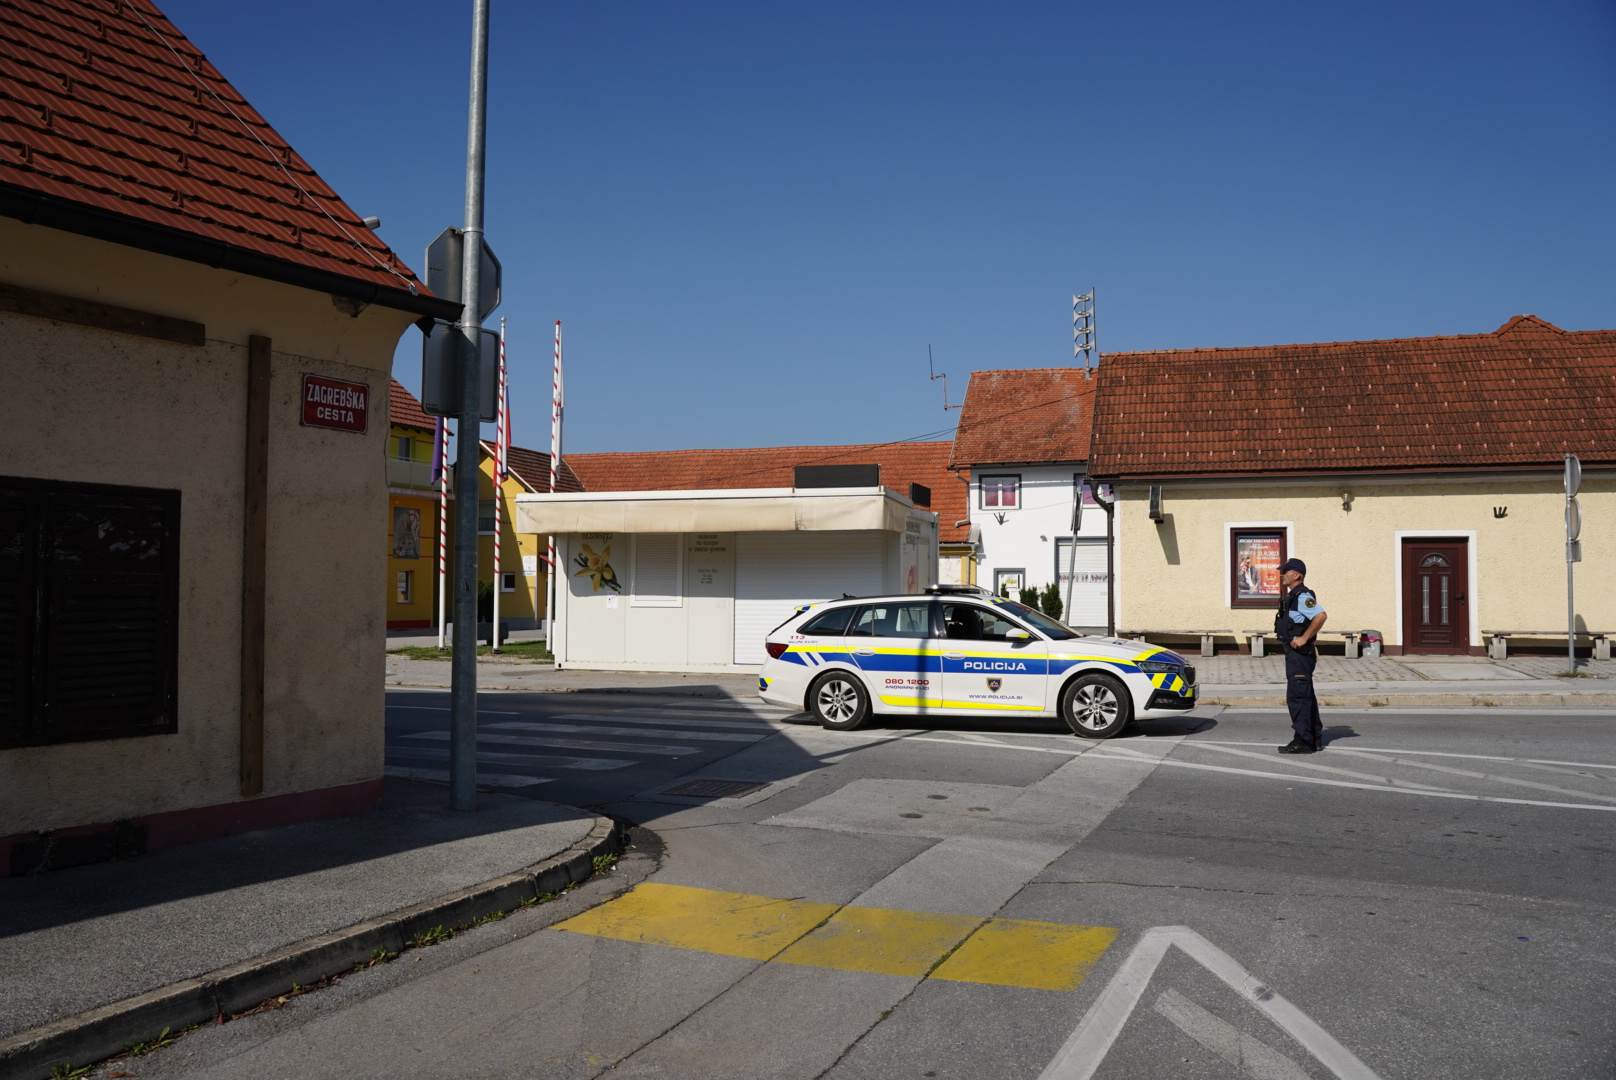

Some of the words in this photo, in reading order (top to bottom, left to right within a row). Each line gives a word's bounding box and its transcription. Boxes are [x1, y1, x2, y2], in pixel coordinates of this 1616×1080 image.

[307, 383, 365, 410] ZAGREBŠKA
[317, 407, 354, 423] CESTA
[963, 661, 1027, 671] POLICIJA
